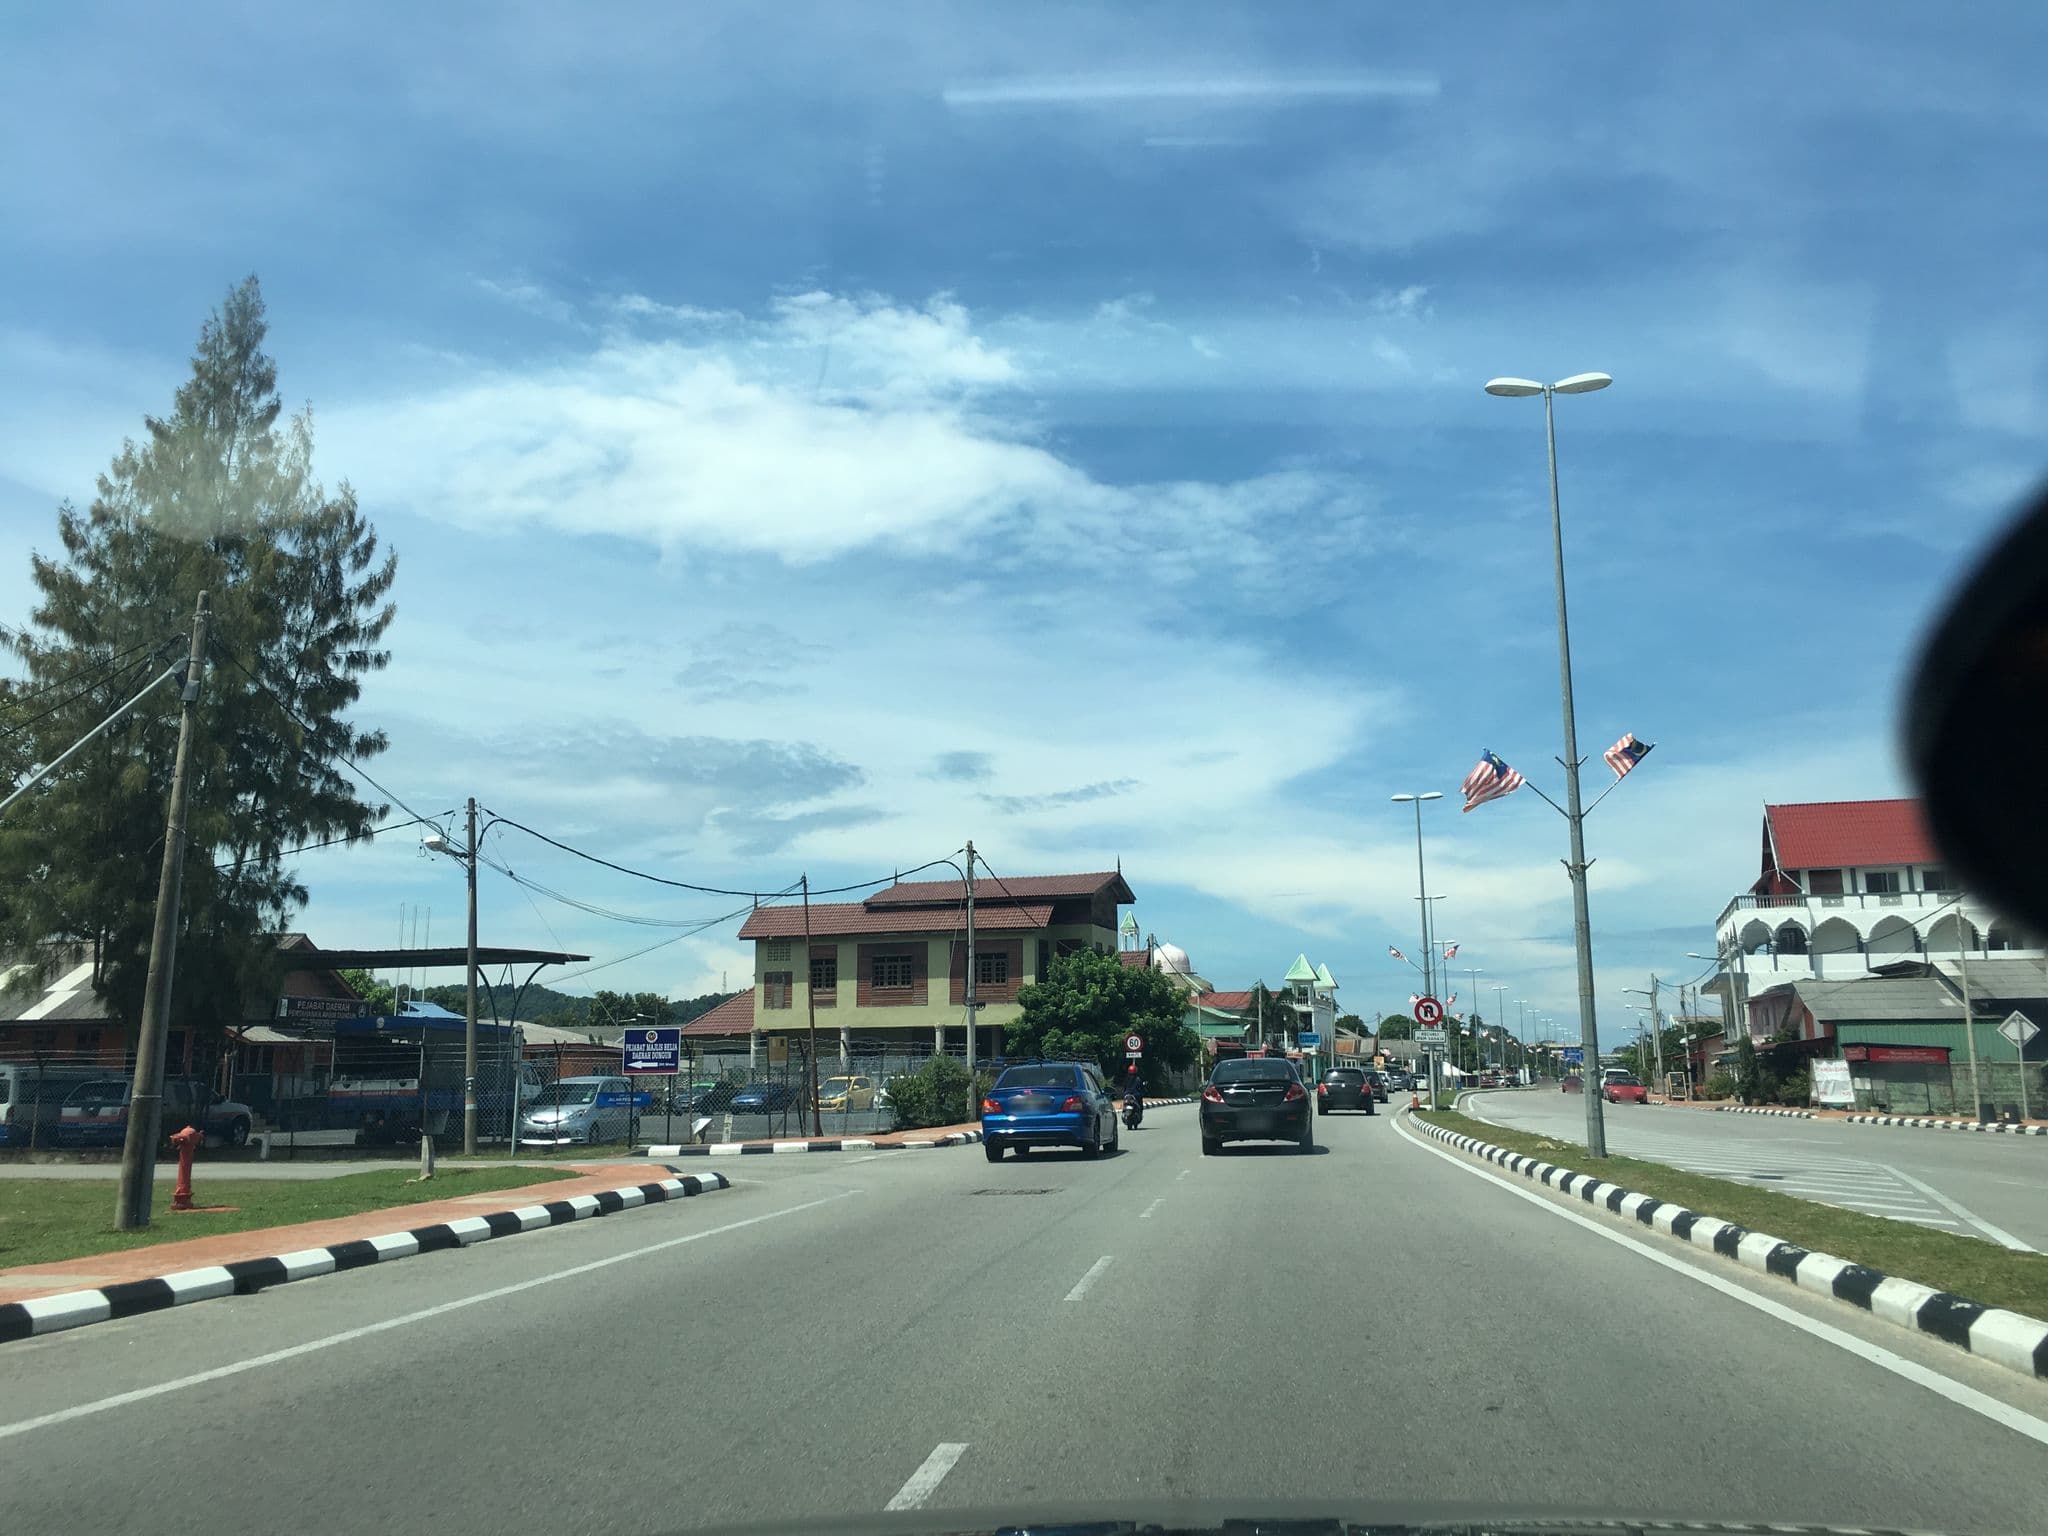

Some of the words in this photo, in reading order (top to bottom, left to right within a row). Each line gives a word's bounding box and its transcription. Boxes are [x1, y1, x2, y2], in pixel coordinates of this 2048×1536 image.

[625, 1043, 646, 1051] PEJABAT
[646, 1043, 663, 1051] MAJLIS
[663, 1043, 678, 1051] BELIA
[1129, 1038, 1139, 1048] 60
[632, 1051, 651, 1060] DAERAH
[651, 1051, 672, 1059] DUNGUN
